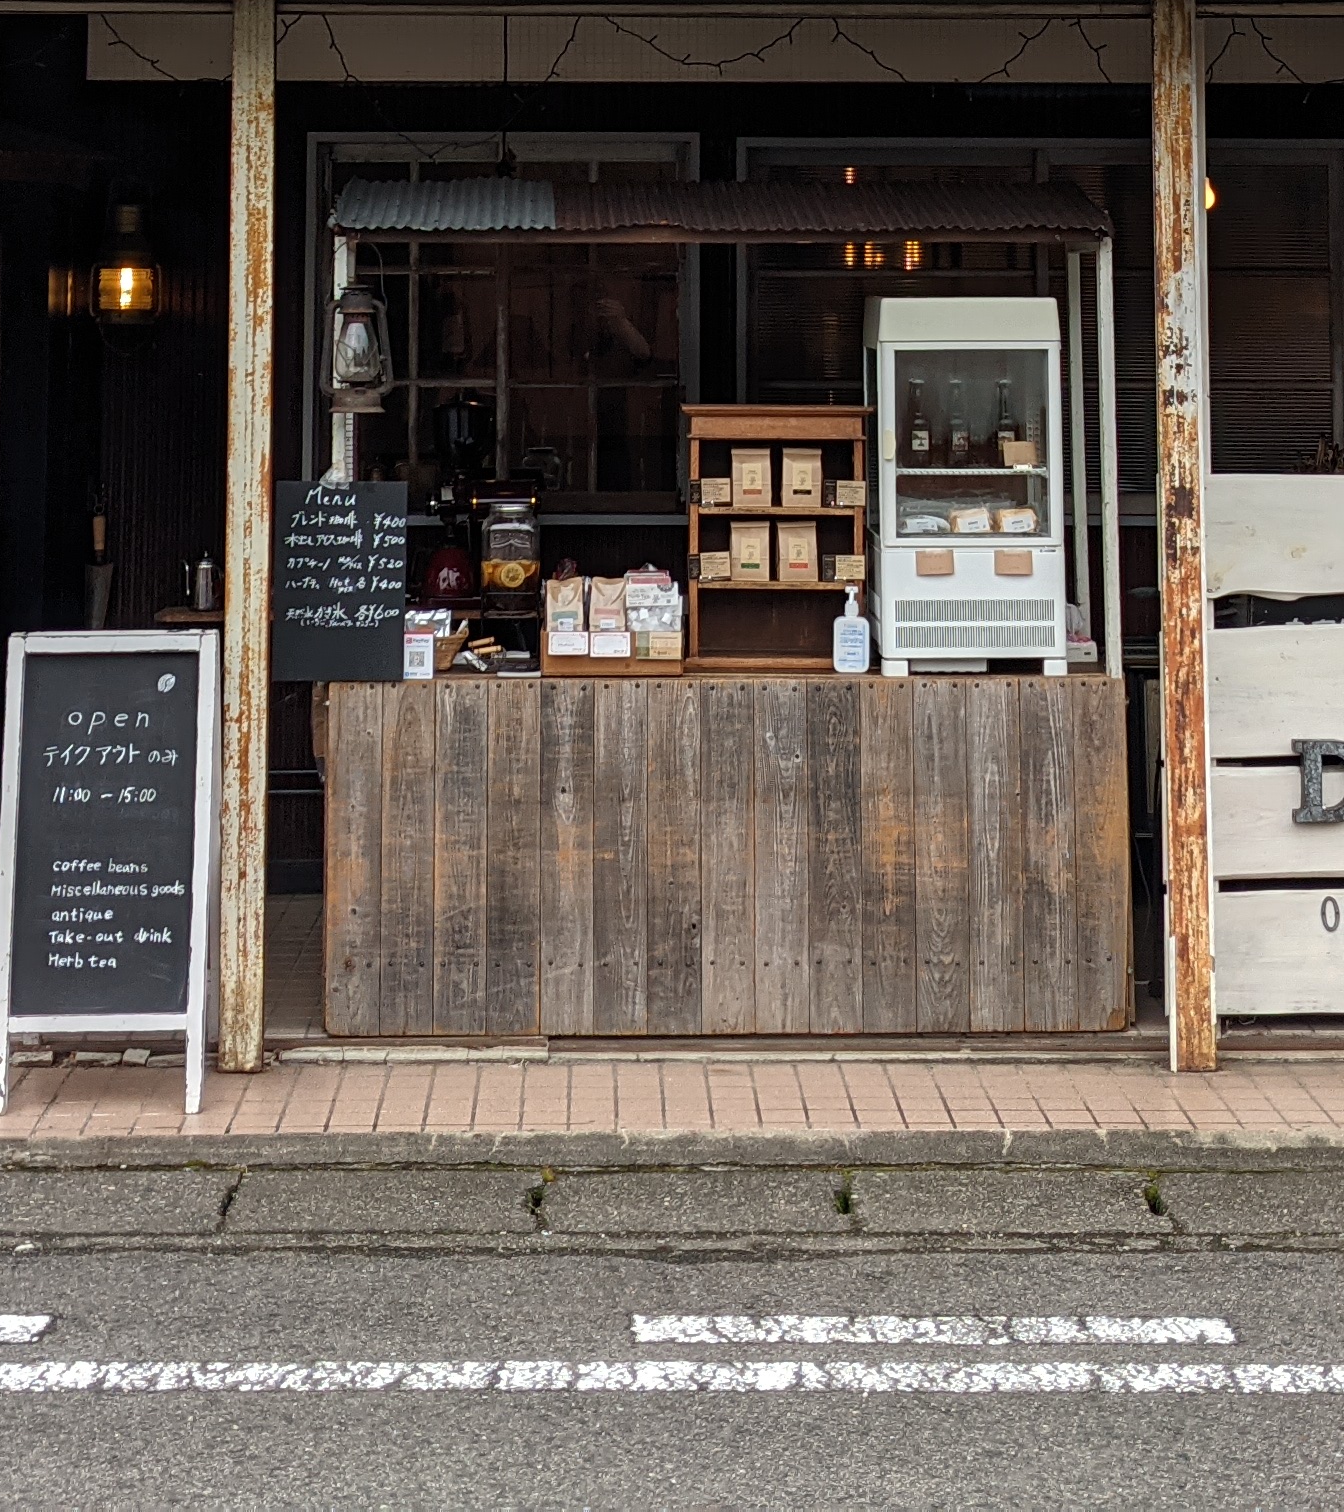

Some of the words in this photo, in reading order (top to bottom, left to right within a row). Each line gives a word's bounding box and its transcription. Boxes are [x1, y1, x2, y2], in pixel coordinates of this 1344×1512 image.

[304, 485, 357, 507] Menu
[372, 532, 406, 549] ¥500
[367, 554, 404, 573] ¥520
[67, 711, 150, 736] open
[107, 857, 149, 874] beans
[50, 880, 149, 898] Miscellaneous
[150, 879, 186, 898] goods
[51, 907, 114, 923] antique
[48, 928, 124, 945] Take-out
[133, 926, 173, 944] drink
[48, 951, 84, 969] Herb
[87, 954, 117, 969] tea
